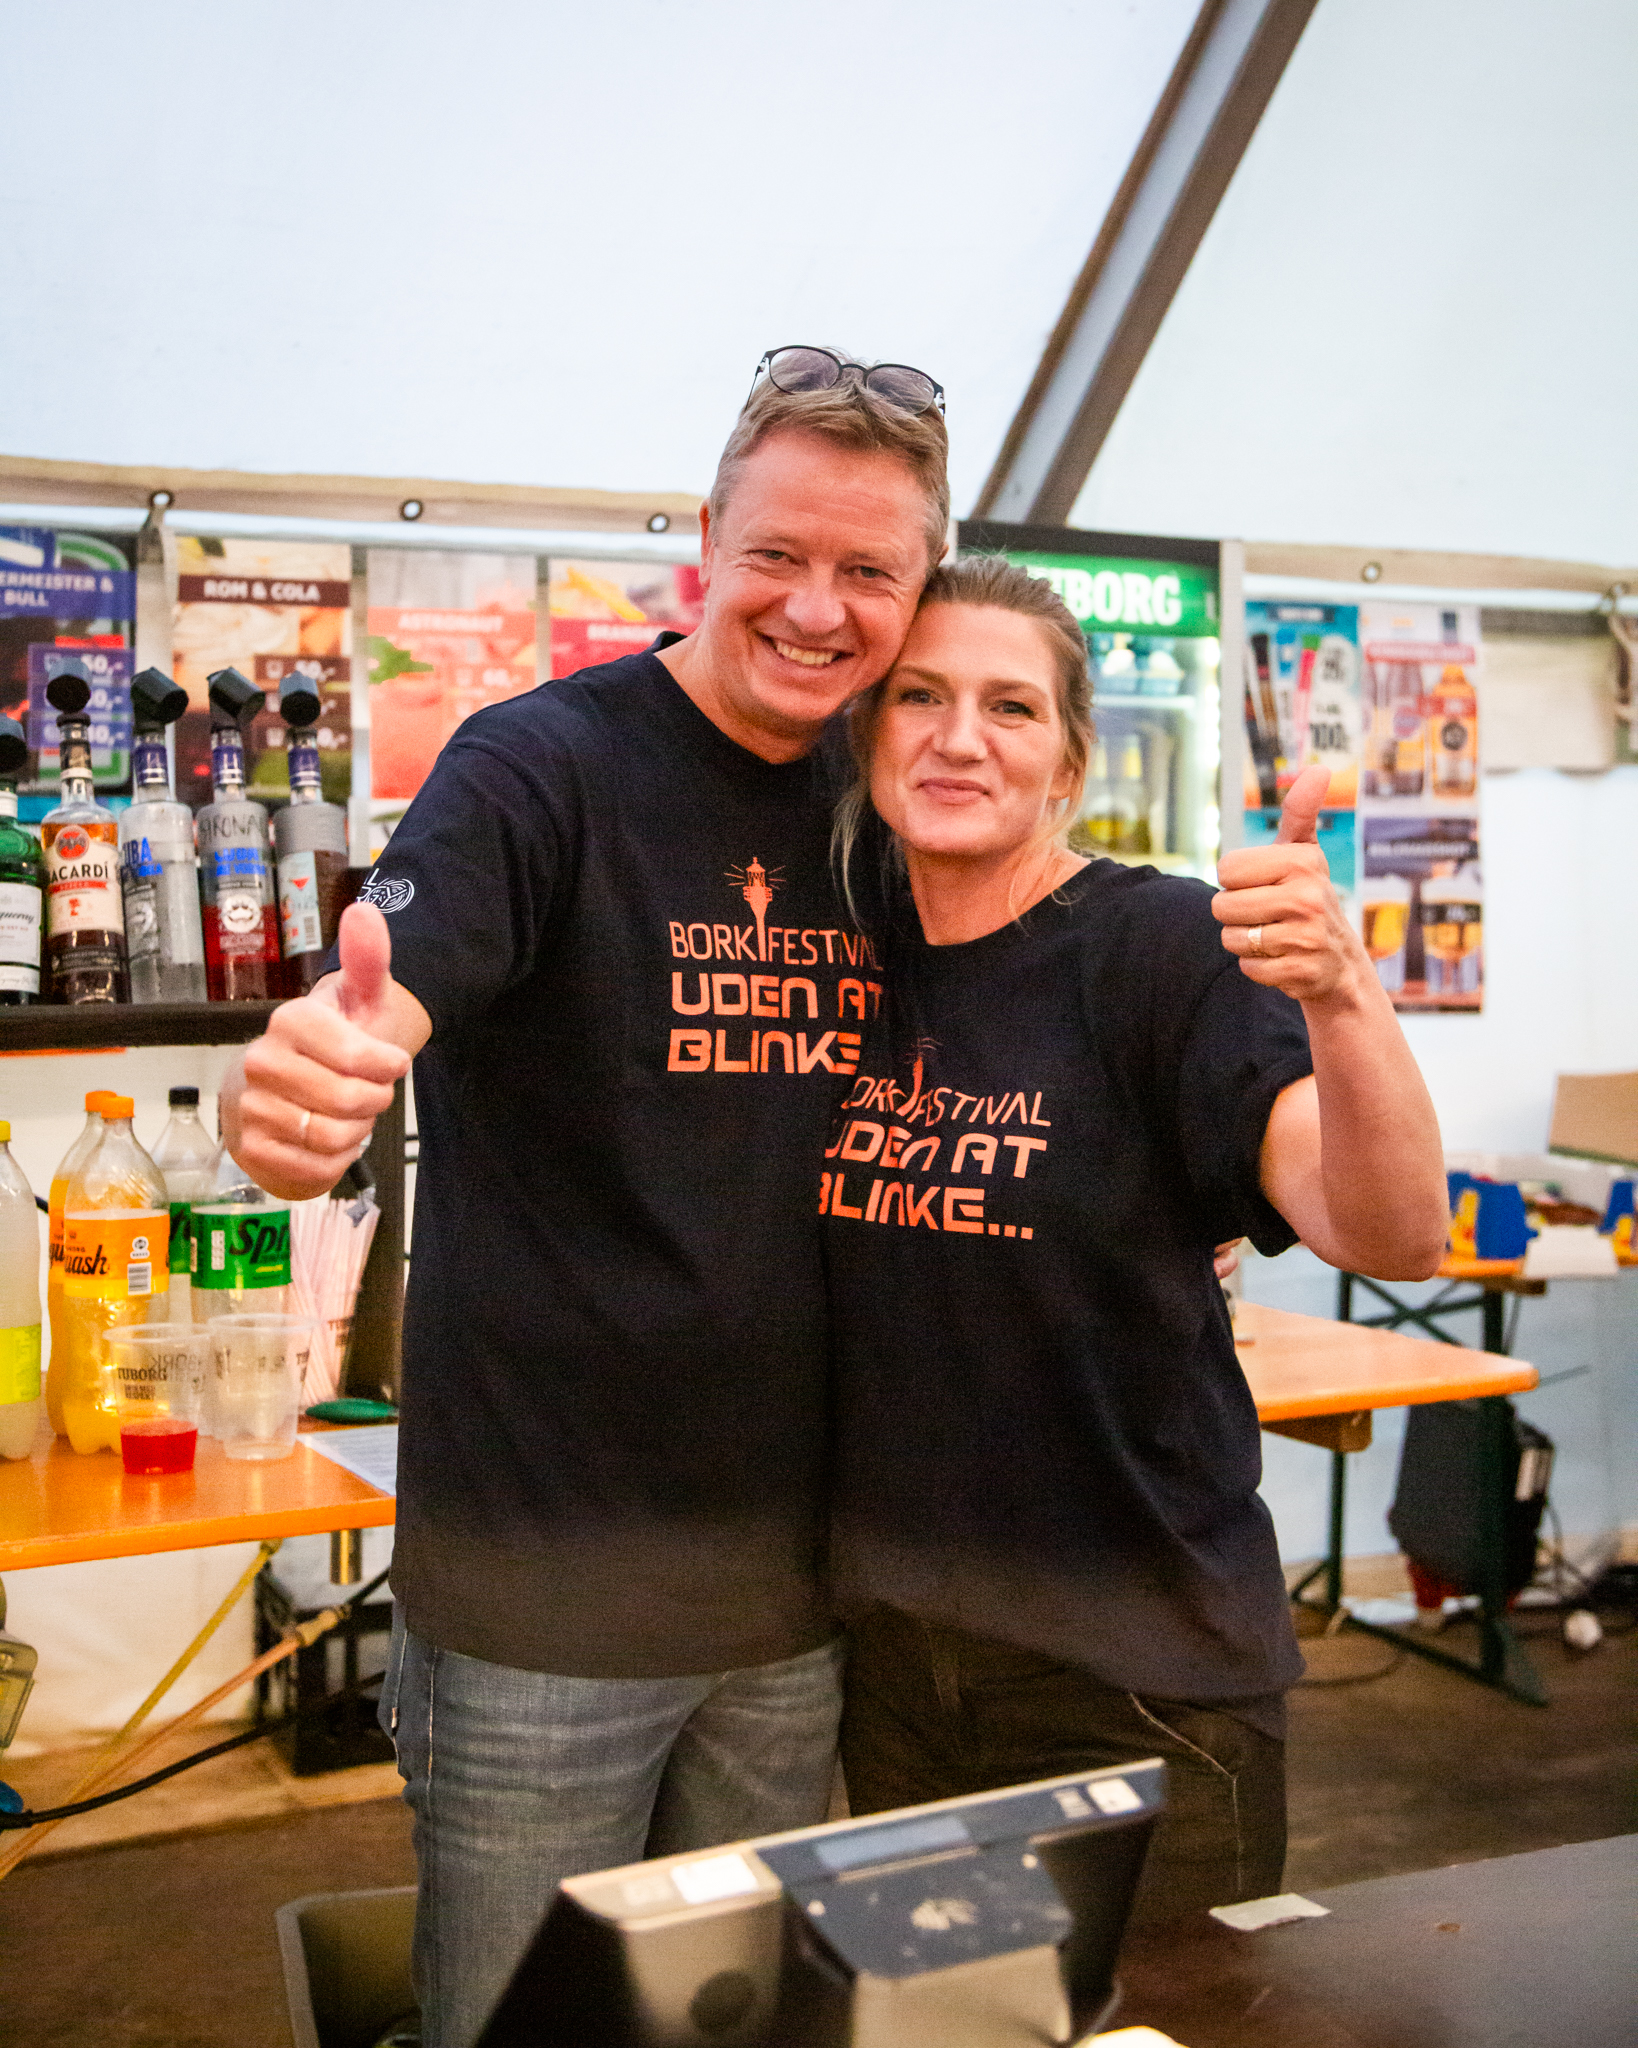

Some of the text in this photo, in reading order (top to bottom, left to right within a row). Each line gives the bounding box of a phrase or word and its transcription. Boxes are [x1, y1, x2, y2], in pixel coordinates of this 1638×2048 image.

[203, 579, 321, 602] ROM & COLA
[669, 921, 757, 961] BORK
[671, 971, 884, 1022] UDEN AT
[667, 1028, 862, 1076] BLINKE
[950, 1132, 1048, 1179] AT
[117, 1367, 168, 1381] TUBORG
